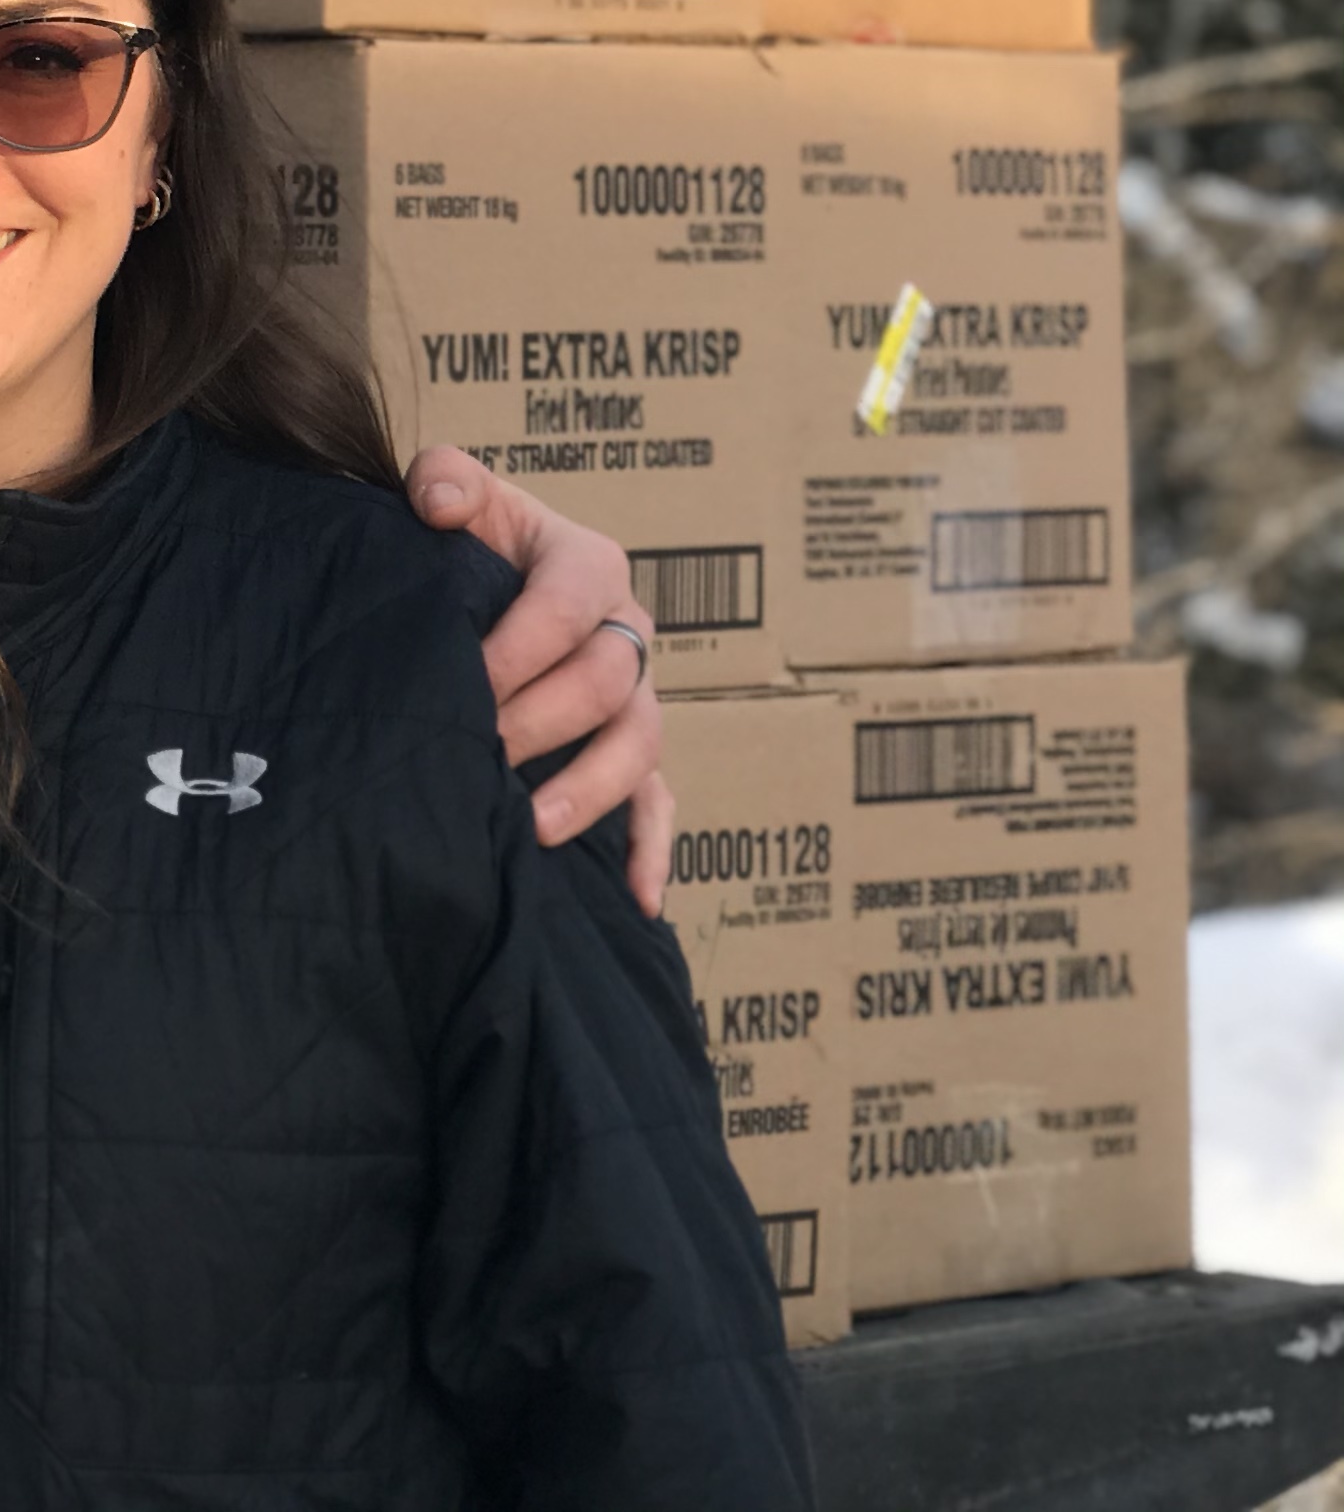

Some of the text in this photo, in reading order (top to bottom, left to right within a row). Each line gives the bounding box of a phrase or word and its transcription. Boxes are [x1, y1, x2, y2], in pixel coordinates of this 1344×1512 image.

[407, 162, 446, 186] BAGS
[573, 163, 766, 217] 1000001128
[951, 149, 1107, 196] 1000001128
[395, 195, 422, 220] NET
[426, 195, 480, 220] WEIGHT
[503, 197, 519, 224] kg
[827, 303, 1089, 349] YUM XTRA KRISP
[422, 330, 741, 383] YUM! EXTRA KRISP
[525, 388, 568, 436] Fried
[507, 442, 598, 474] STRAIGHT
[604, 441, 639, 471] CUT
[643, 438, 712, 469] COATED
[666, 823, 831, 886] 00001128
[854, 970, 933, 1022] KRIS
[942, 961, 1046, 1012] EXTRA
[722, 990, 821, 1045] KRISP
[727, 1096, 810, 1139] ENROBÉE
[849, 1118, 1014, 1185] 100000112
